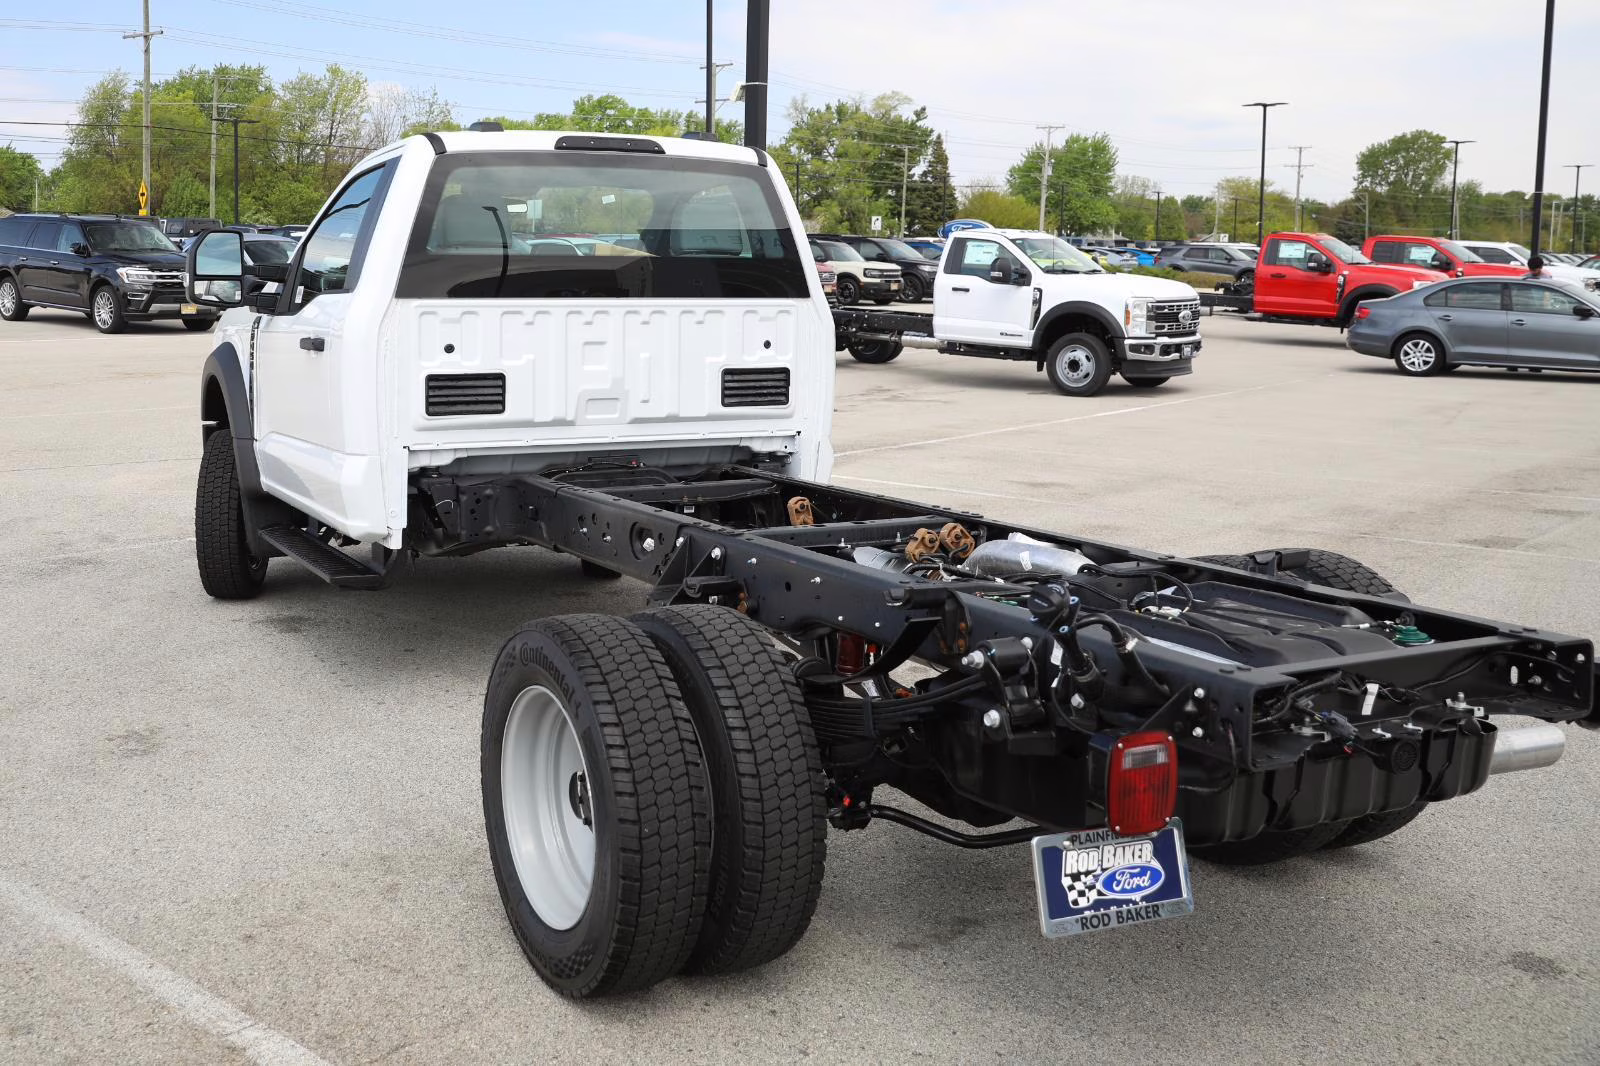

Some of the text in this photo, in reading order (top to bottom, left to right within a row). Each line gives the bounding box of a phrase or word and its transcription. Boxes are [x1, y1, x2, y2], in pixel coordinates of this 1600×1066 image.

[521, 642, 575, 705] Continental
[1071, 830, 1130, 845] PLAINFI
[1065, 843, 1152, 874] ROD BAKER
[1112, 868, 1151, 891] Ford
[1080, 912, 1111, 930] ROD
[1116, 904, 1162, 924] BAKER
